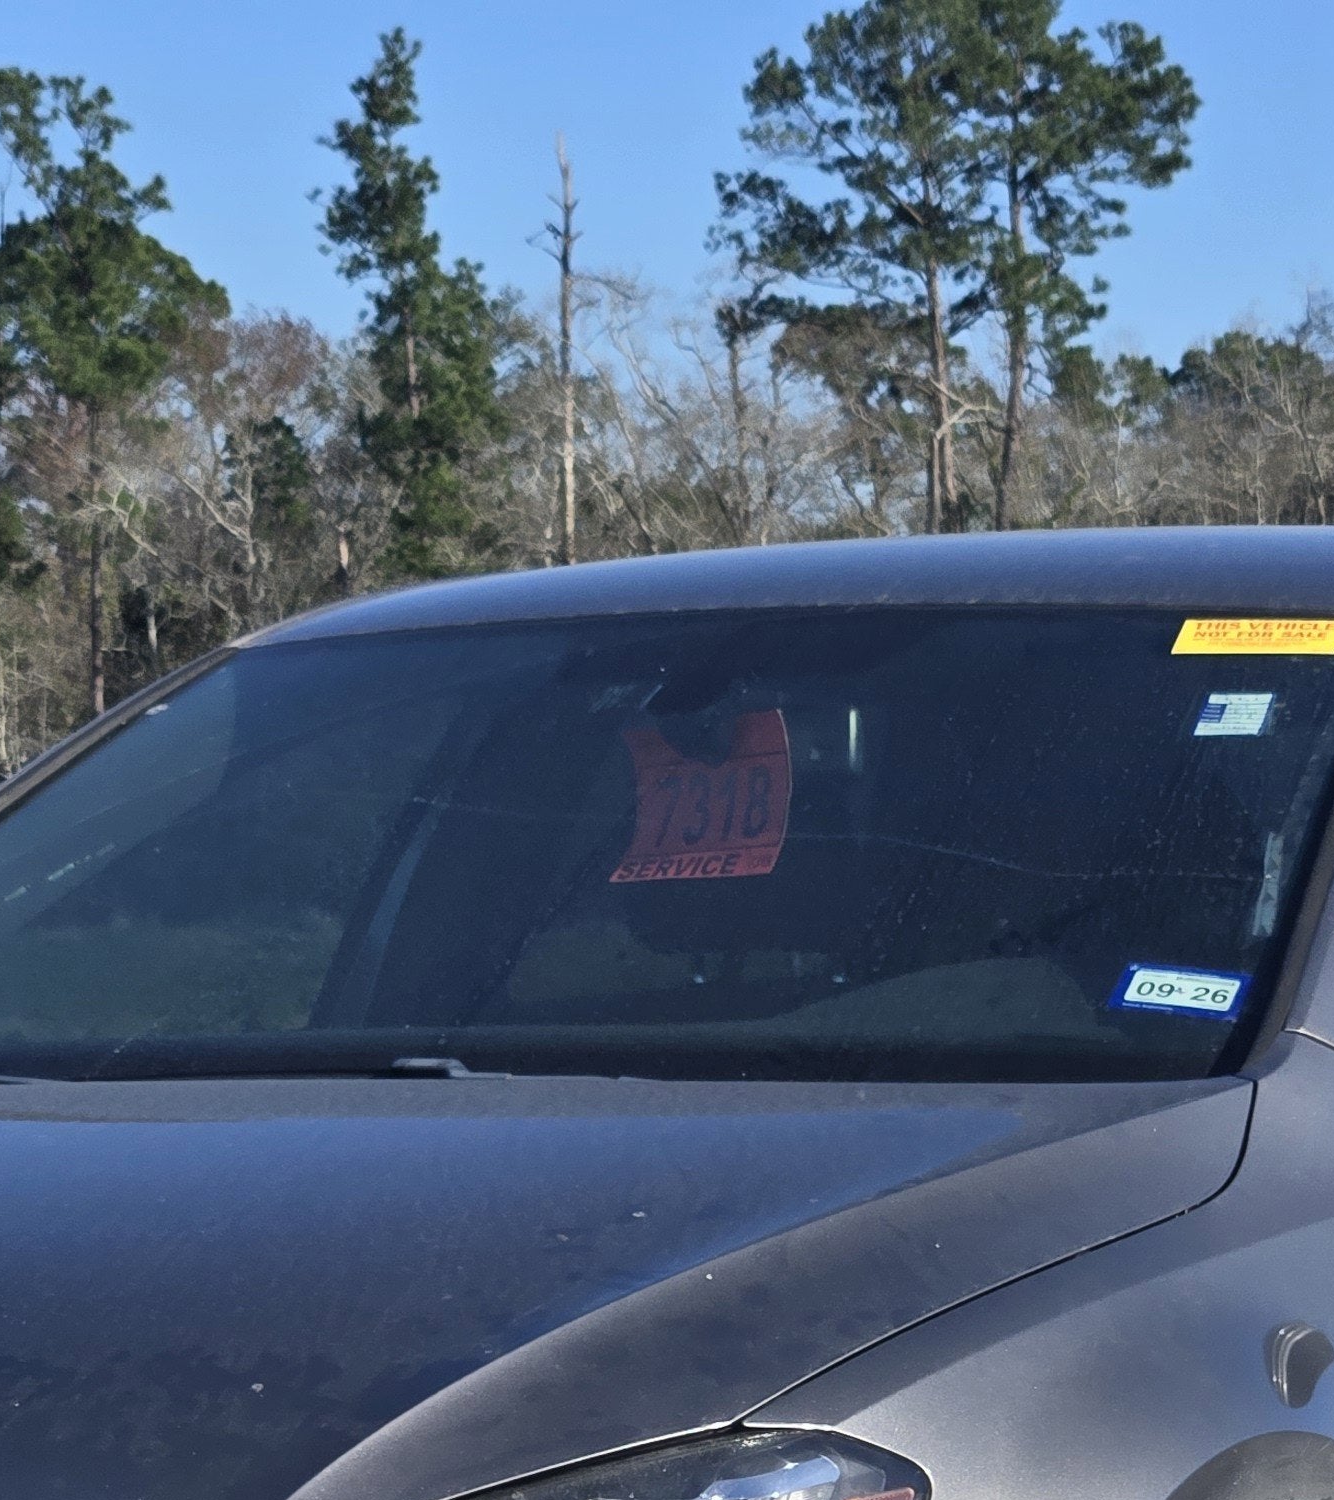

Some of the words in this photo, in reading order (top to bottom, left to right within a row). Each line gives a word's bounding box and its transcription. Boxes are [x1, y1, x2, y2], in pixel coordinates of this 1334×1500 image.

[1195, 622, 1242, 630] THIS
[1280, 631, 1329, 639] SALE
[616, 853, 741, 878] SERVICE
